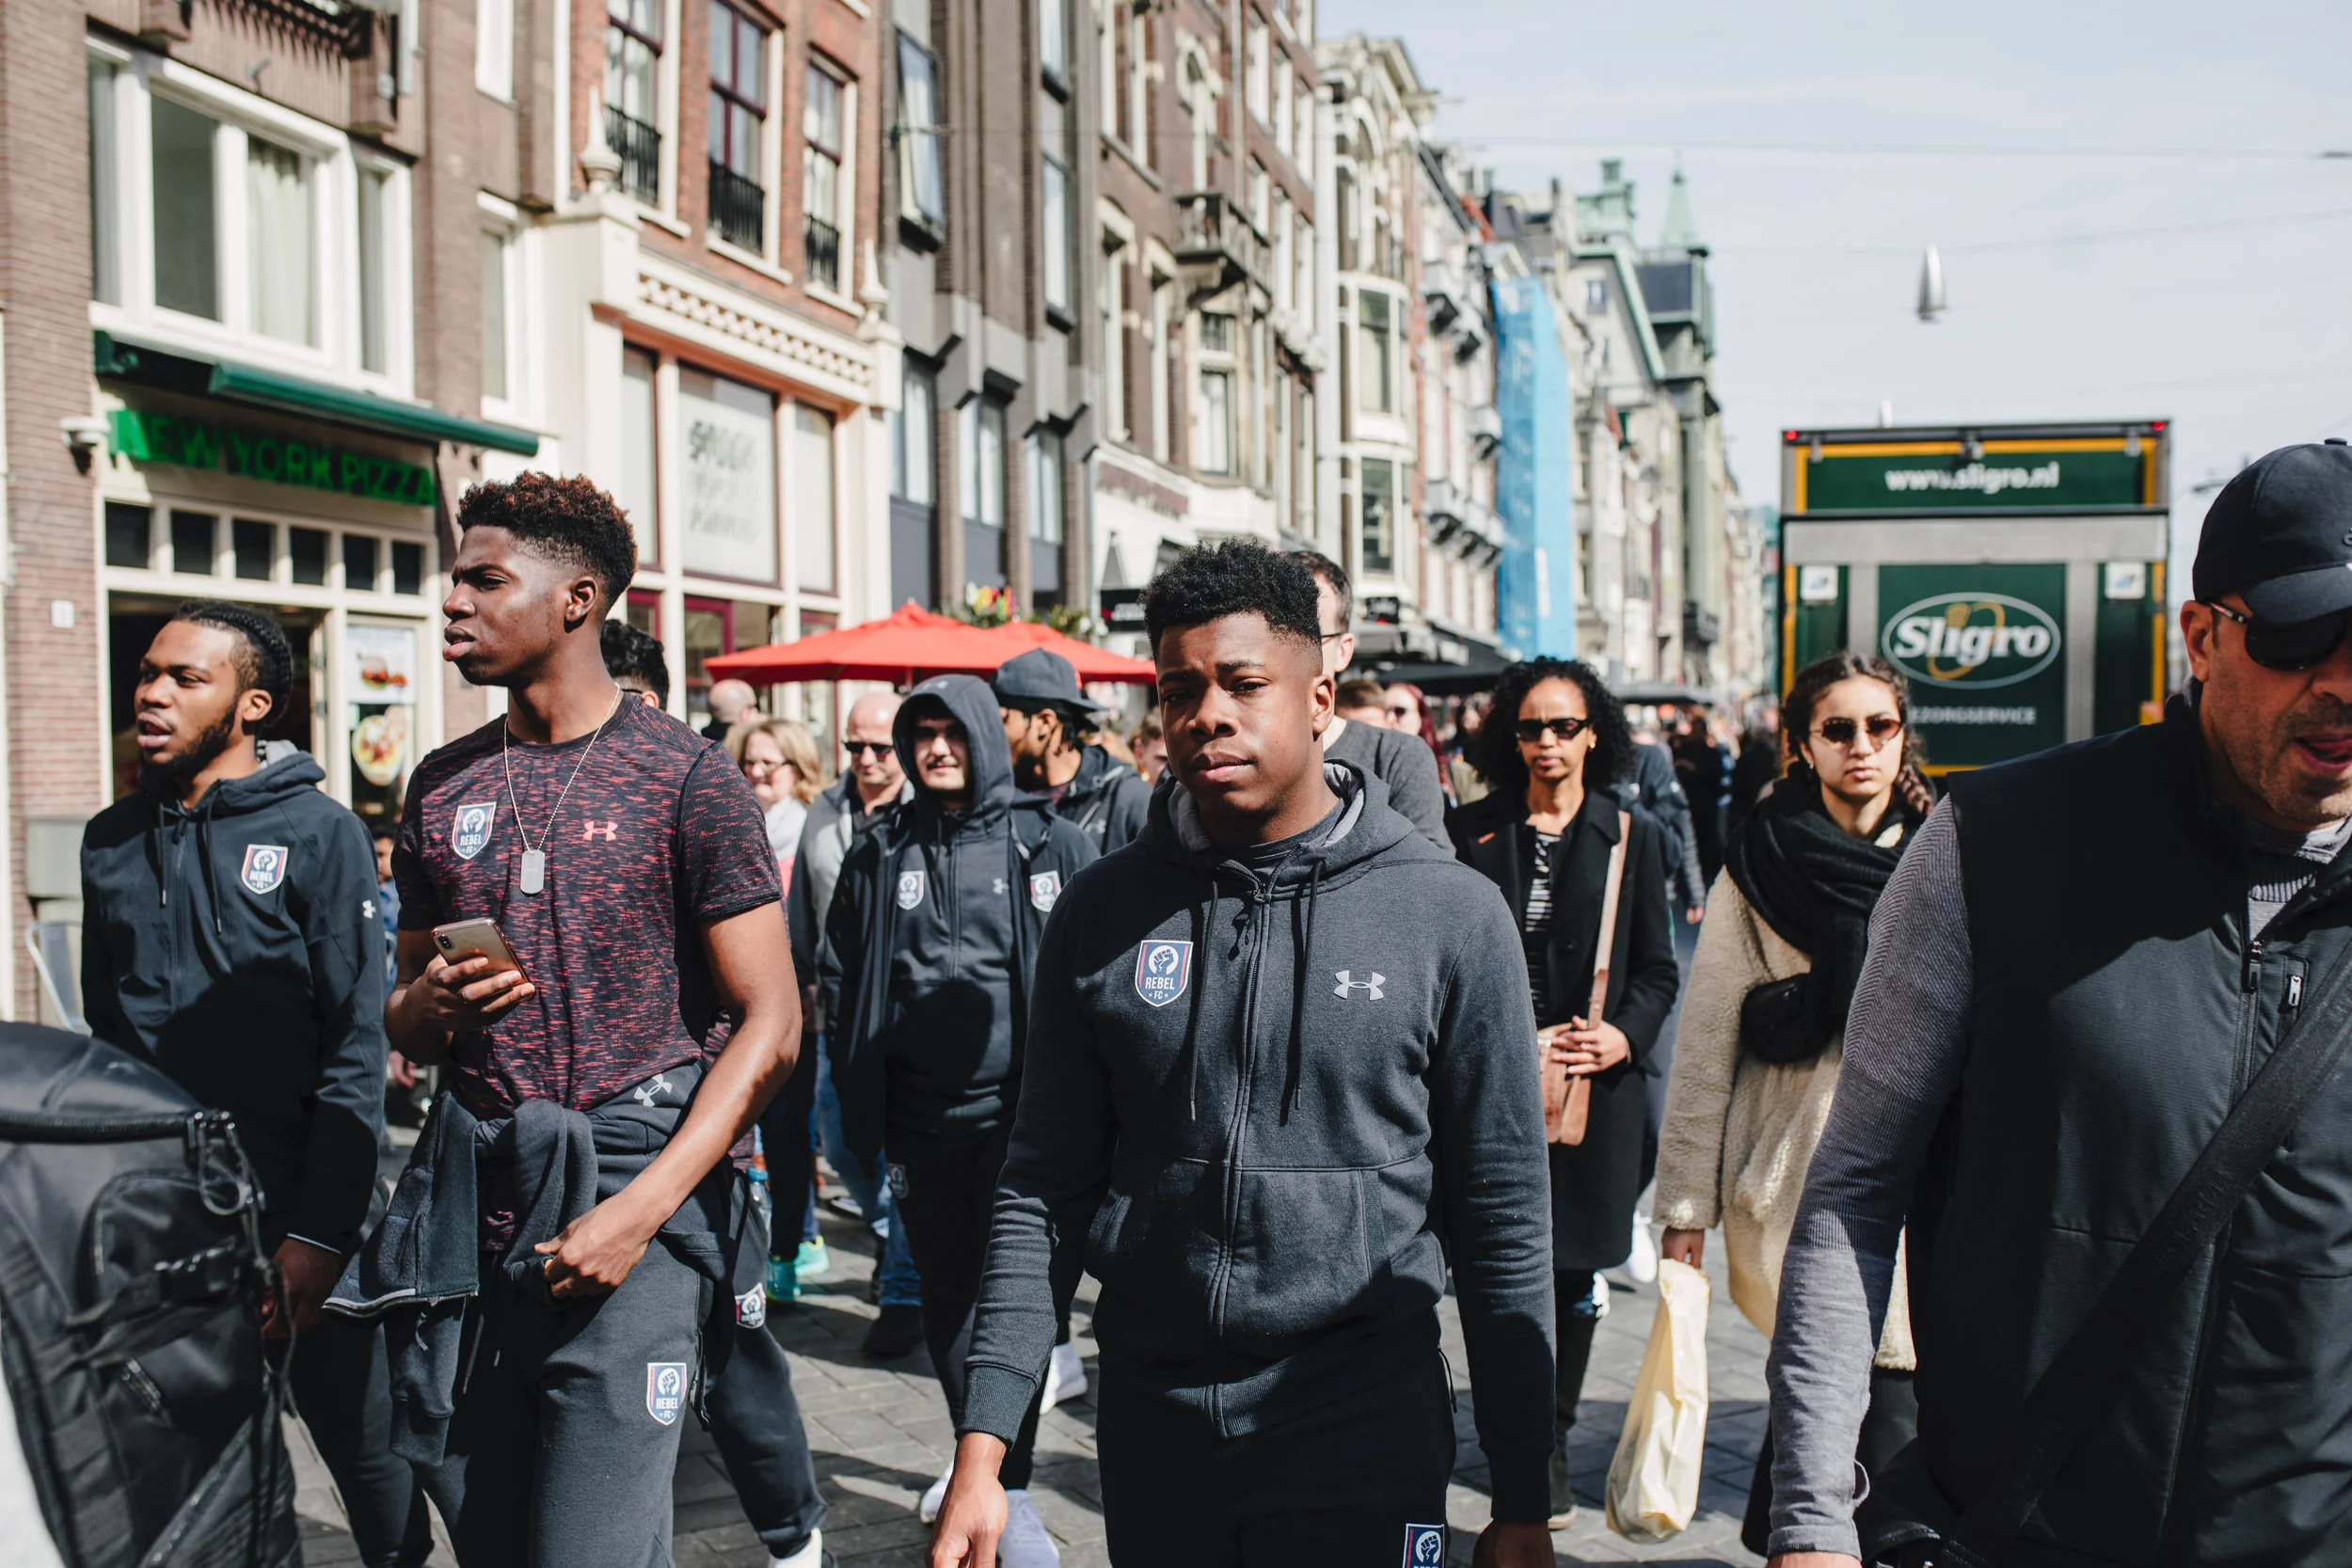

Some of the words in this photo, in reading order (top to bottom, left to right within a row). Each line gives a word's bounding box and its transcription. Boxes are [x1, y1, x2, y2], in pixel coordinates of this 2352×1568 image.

[110, 408, 219, 469] NEW
[230, 432, 335, 493] YORK
[341, 451, 438, 508] PIZZA
[1884, 460, 2060, 495] www.sligro.nl
[1893, 615, 2051, 666] Sligro
[1908, 706, 2038, 724] EZORGSERVICE
[460, 833, 482, 847] REBEL
[1145, 976, 1175, 990] REBEL
[1153, 990, 1163, 1000] FC
[656, 1397, 678, 1409] REBEL
